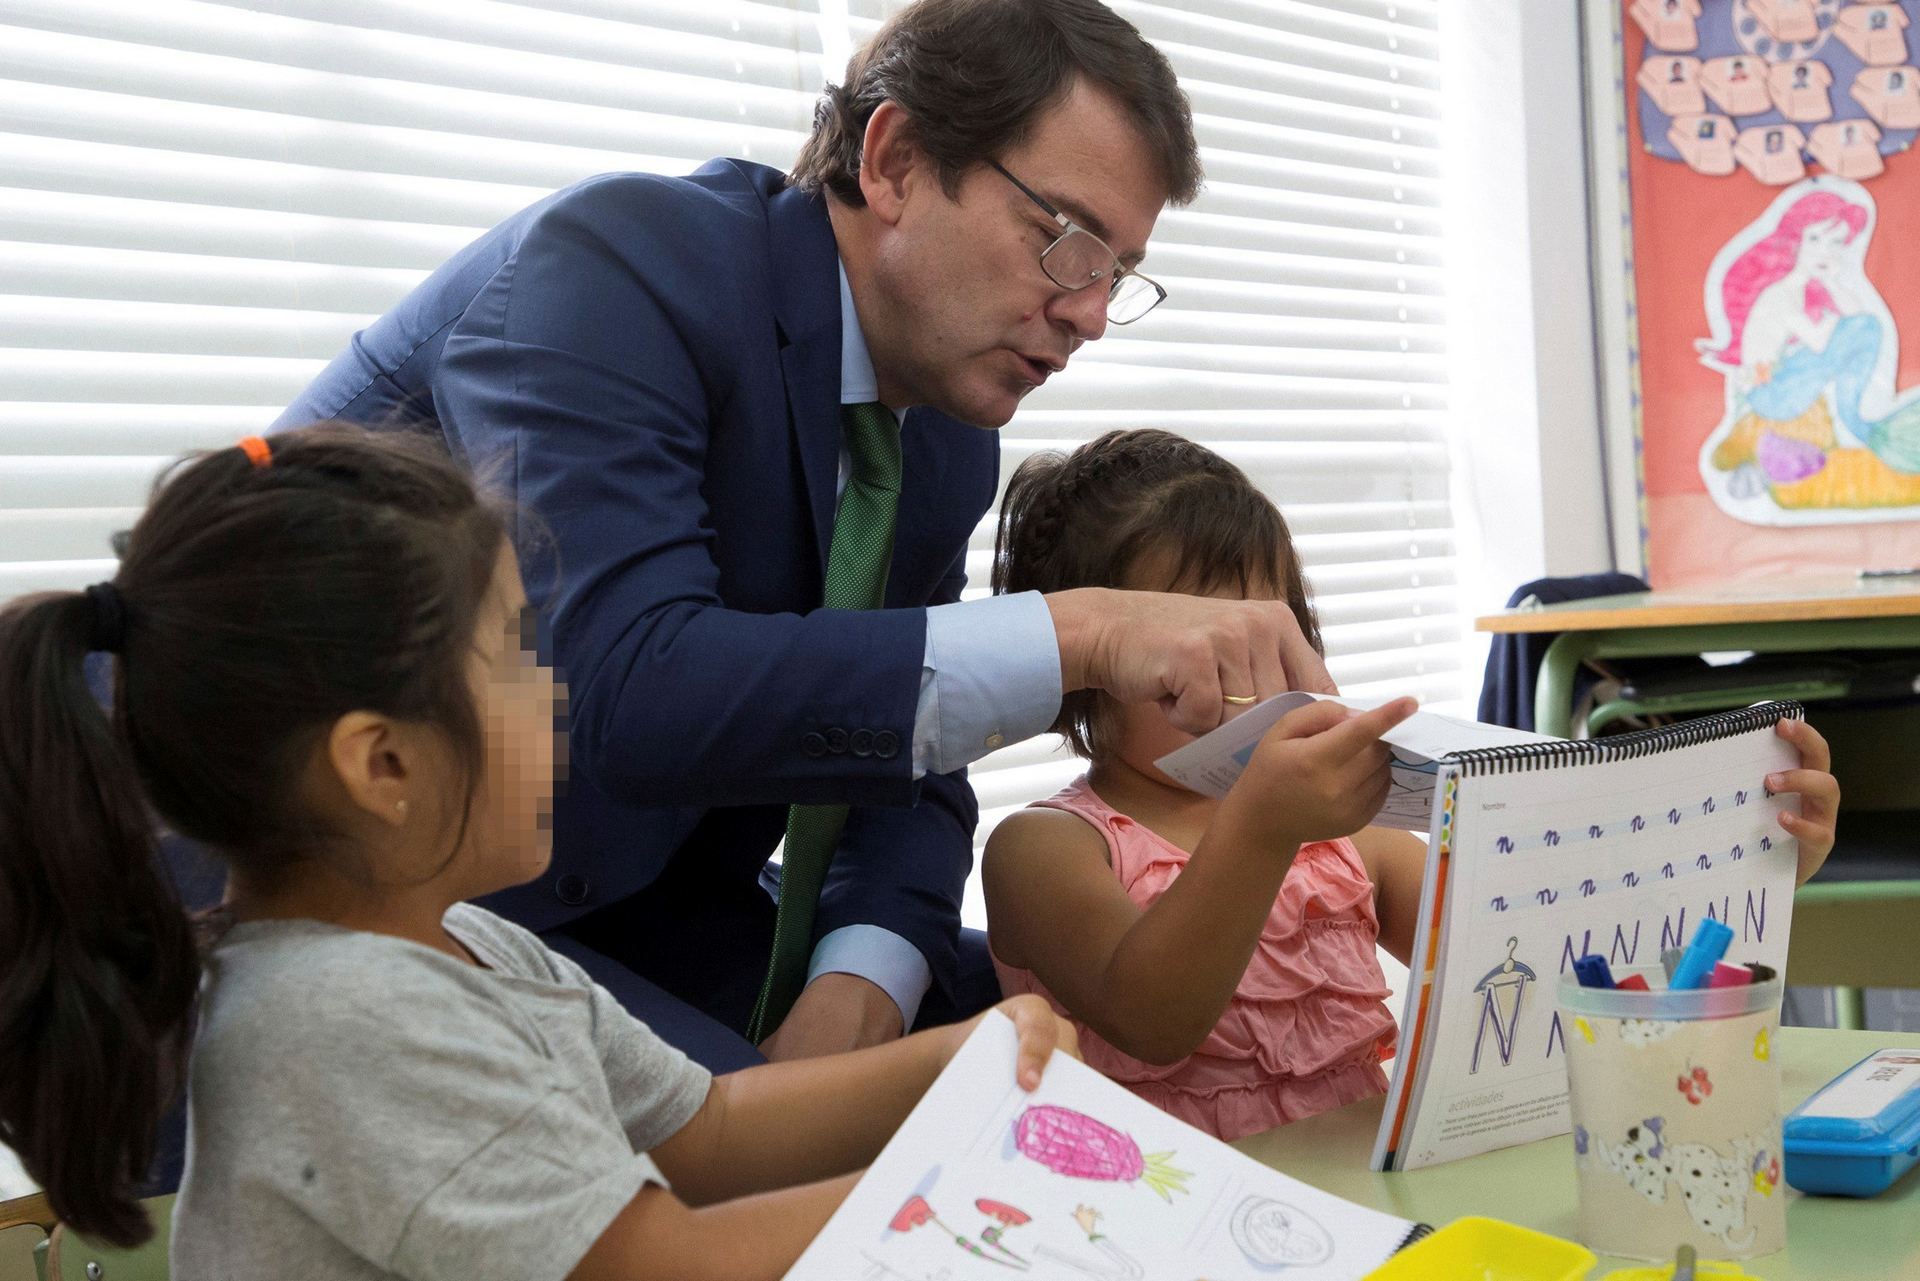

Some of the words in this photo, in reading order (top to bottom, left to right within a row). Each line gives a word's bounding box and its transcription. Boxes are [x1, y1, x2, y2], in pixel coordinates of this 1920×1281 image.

[1496, 836, 1515, 854] n
[1543, 830, 1561, 847] n
[1588, 825, 1604, 838] n
[1631, 815, 1645, 833] n
[1667, 808, 1681, 825] n
[1702, 796, 1715, 815] n
[1734, 790, 1748, 806] n
[1490, 896, 1509, 911] n
[1535, 888, 1558, 905] n
[1579, 879, 1596, 897] n
[1622, 872, 1640, 887] n
[1661, 862, 1675, 878] n
[1696, 854, 1712, 870] n
[1730, 844, 1744, 861] n
[1759, 836, 1772, 851] n
[1610, 920, 1640, 965] N
[1745, 888, 1766, 943] N
[1469, 974, 1527, 1075] N
